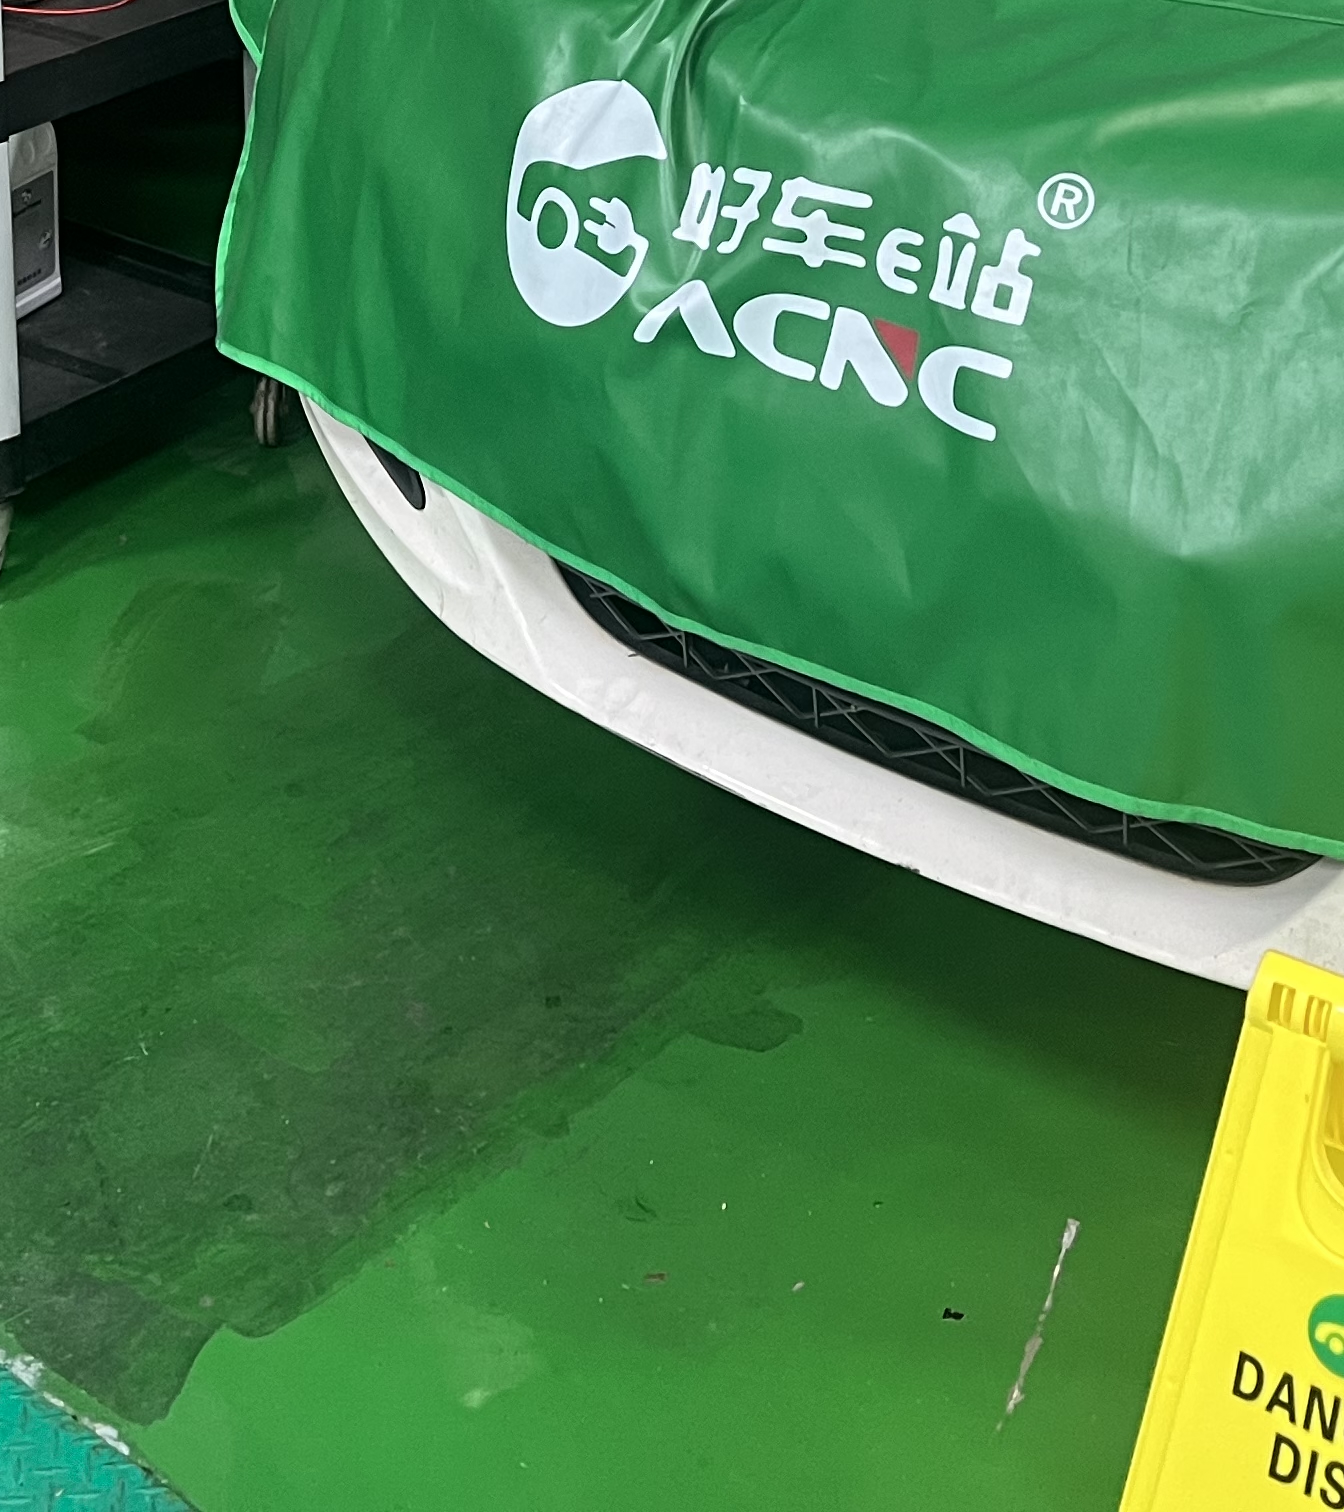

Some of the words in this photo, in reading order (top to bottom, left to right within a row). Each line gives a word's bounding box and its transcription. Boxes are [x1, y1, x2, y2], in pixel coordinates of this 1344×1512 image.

[672, 162, 1041, 326] 好车e站
[633, 279, 1014, 443] ACNC
